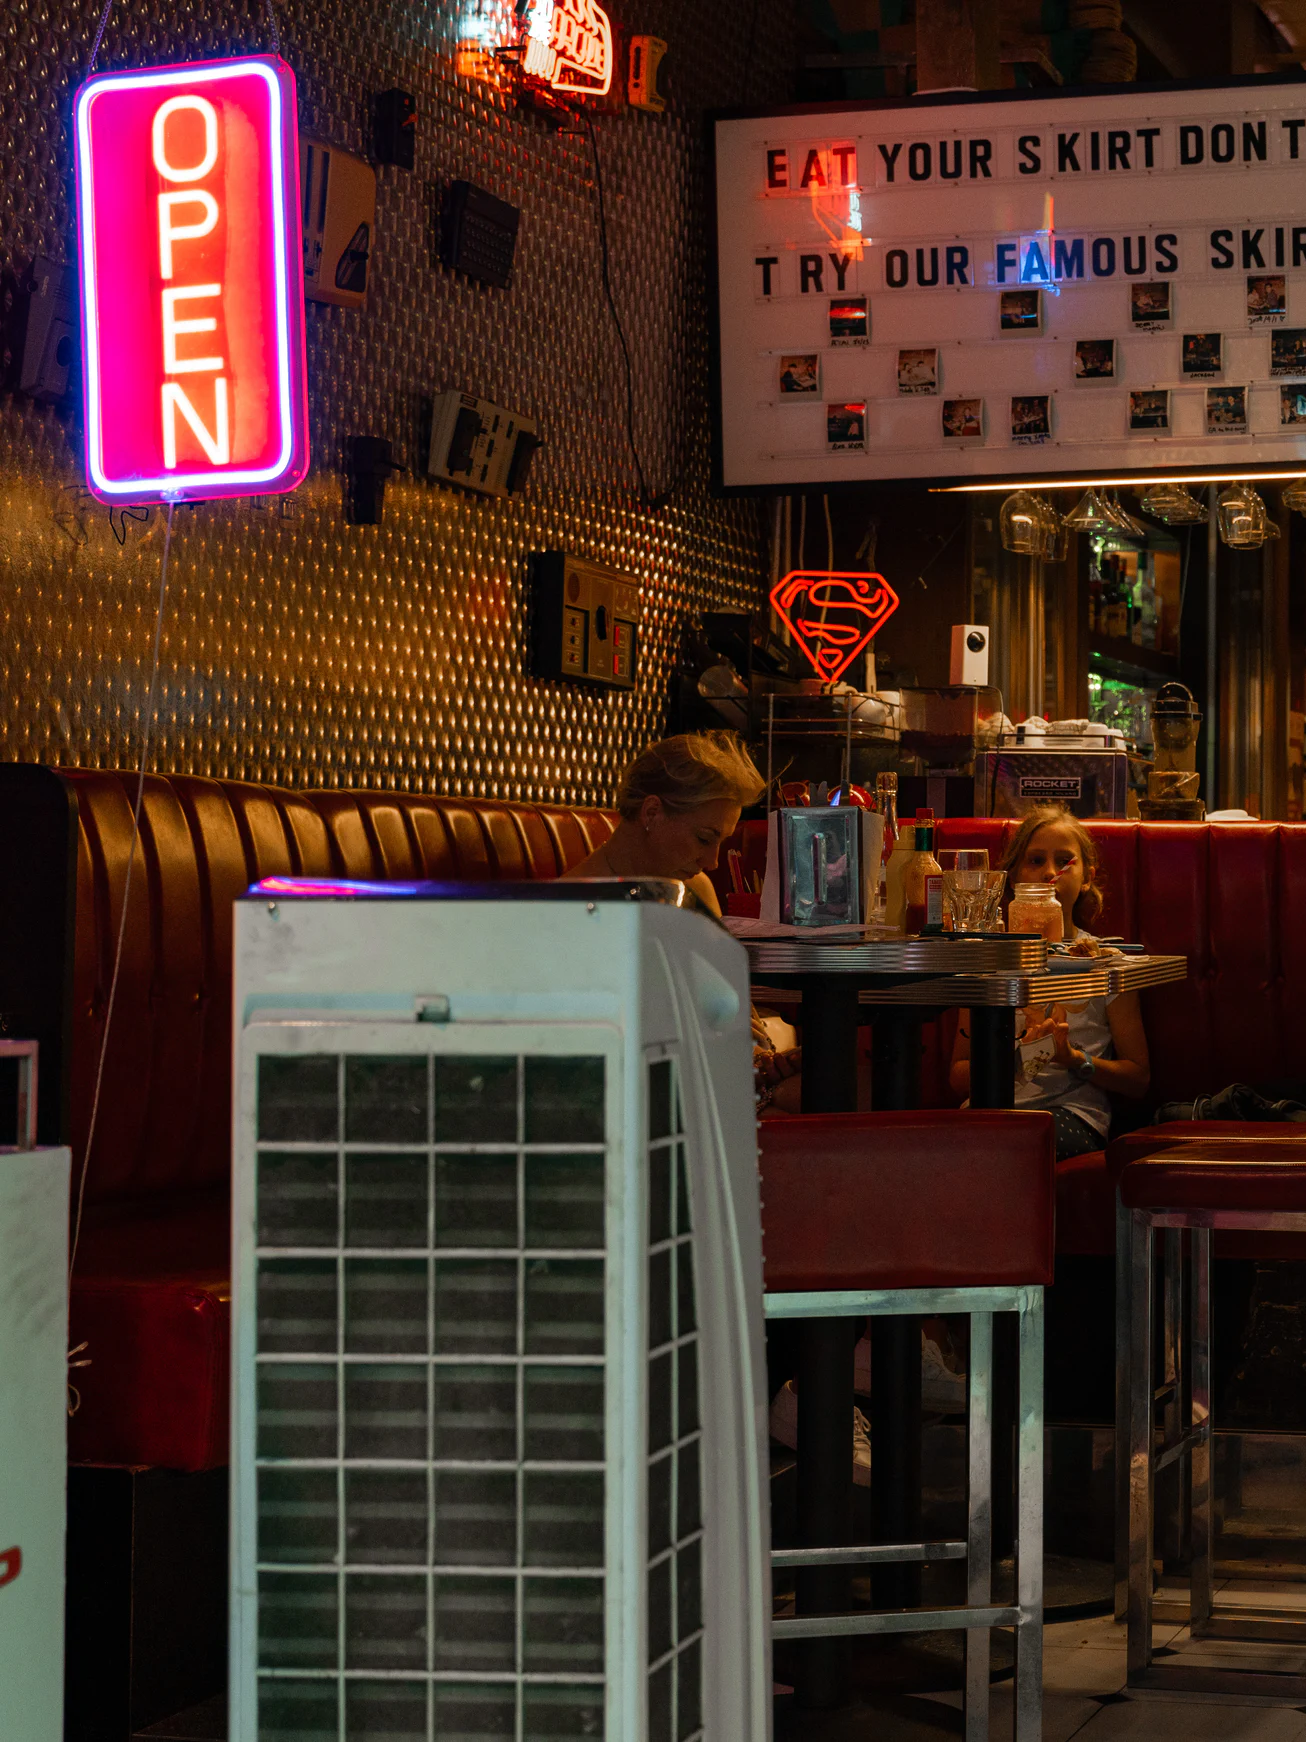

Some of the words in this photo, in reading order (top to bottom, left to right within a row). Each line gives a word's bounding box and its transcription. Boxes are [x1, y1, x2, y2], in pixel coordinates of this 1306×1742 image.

[766, 146, 856, 188] EAT
[877, 139, 993, 183] YOUR
[1018, 128, 1161, 175] SKIRT
[153, 95, 230, 469] OPEN
[755, 252, 852, 296] TRY
[885, 246, 969, 288] OUR
[997, 234, 1179, 284] FAMOUS
[1024, 780, 1076, 788] ROCKET
